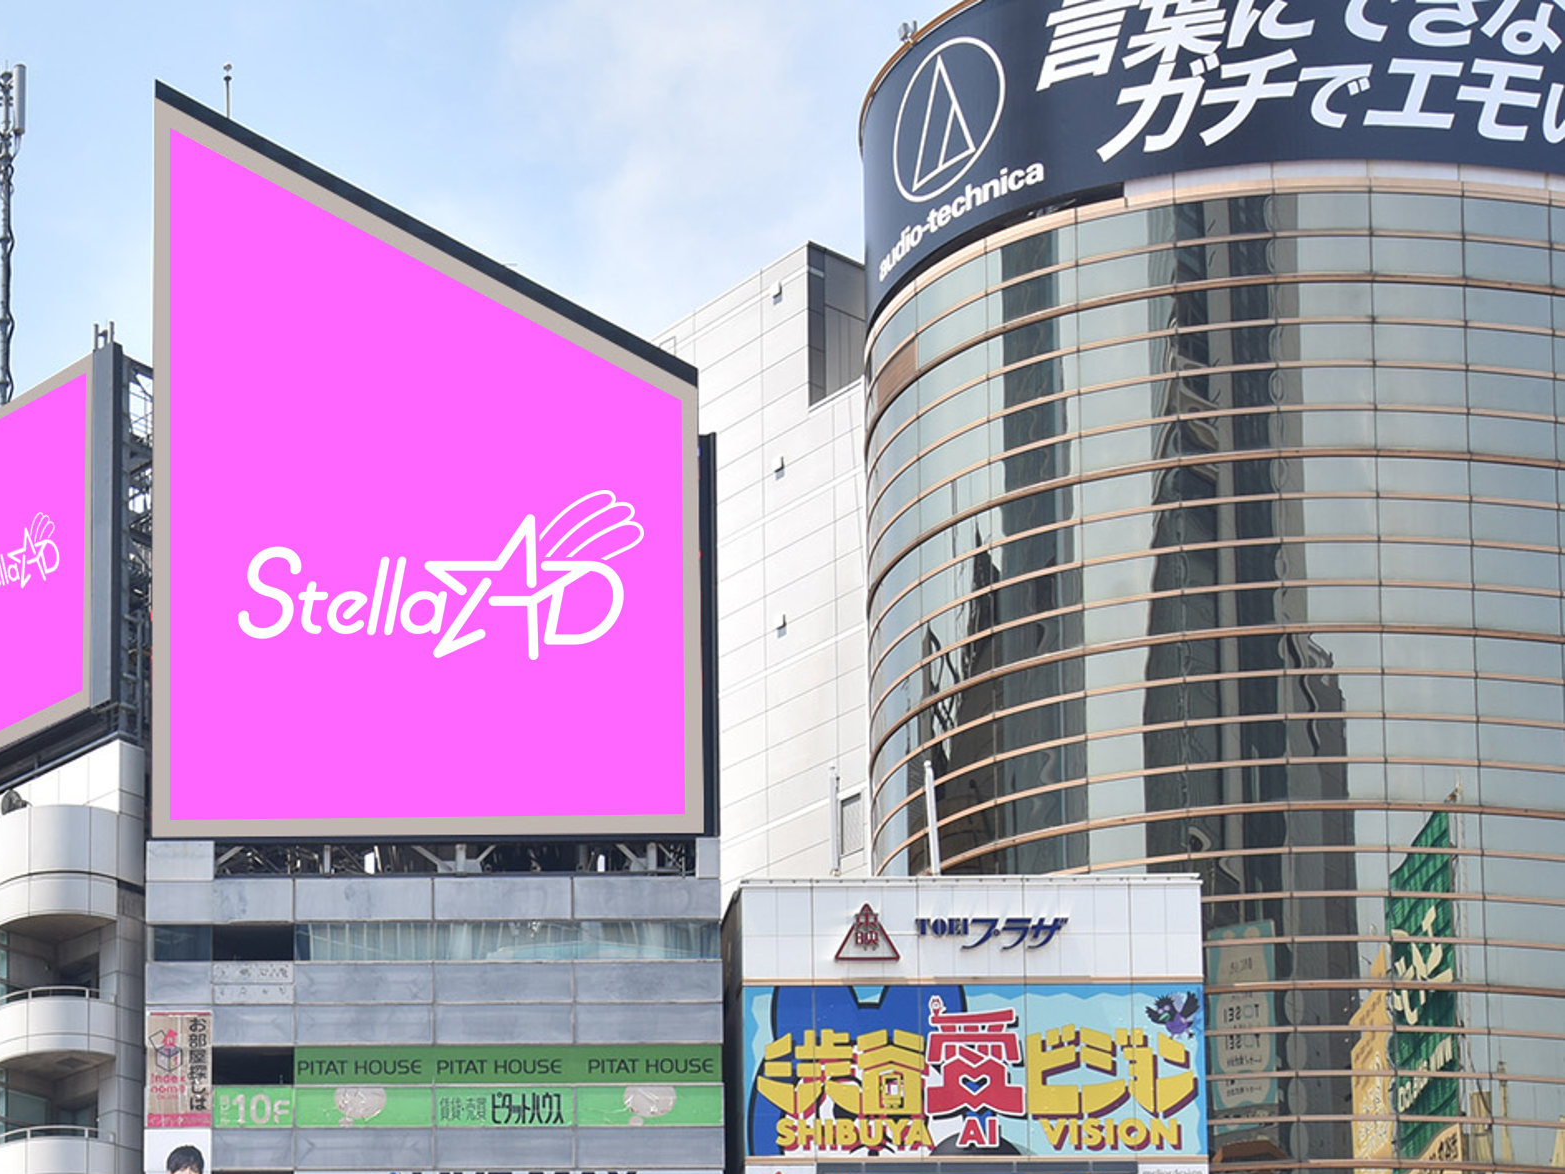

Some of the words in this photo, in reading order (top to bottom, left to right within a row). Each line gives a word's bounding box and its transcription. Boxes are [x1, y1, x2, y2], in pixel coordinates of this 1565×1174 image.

[878, 160, 1046, 283] audio-technica
[189, 1017, 208, 1111] お部屋探しは
[298, 1059, 348, 1076] PITAT
[354, 1059, 423, 1076] HOUSE
[437, 1059, 488, 1076] PITAT
[493, 1058, 563, 1075] HOUSE
[587, 1057, 640, 1075] PITAT
[645, 1057, 715, 1074] HOUSE
[232, 1094, 291, 1124] 10F
[491, 1091, 565, 1125] ピタットハウス
[775, 1117, 934, 1149] SHIBUYA
[956, 1117, 998, 1148] AI
[1039, 1118, 1181, 1150] VISION
